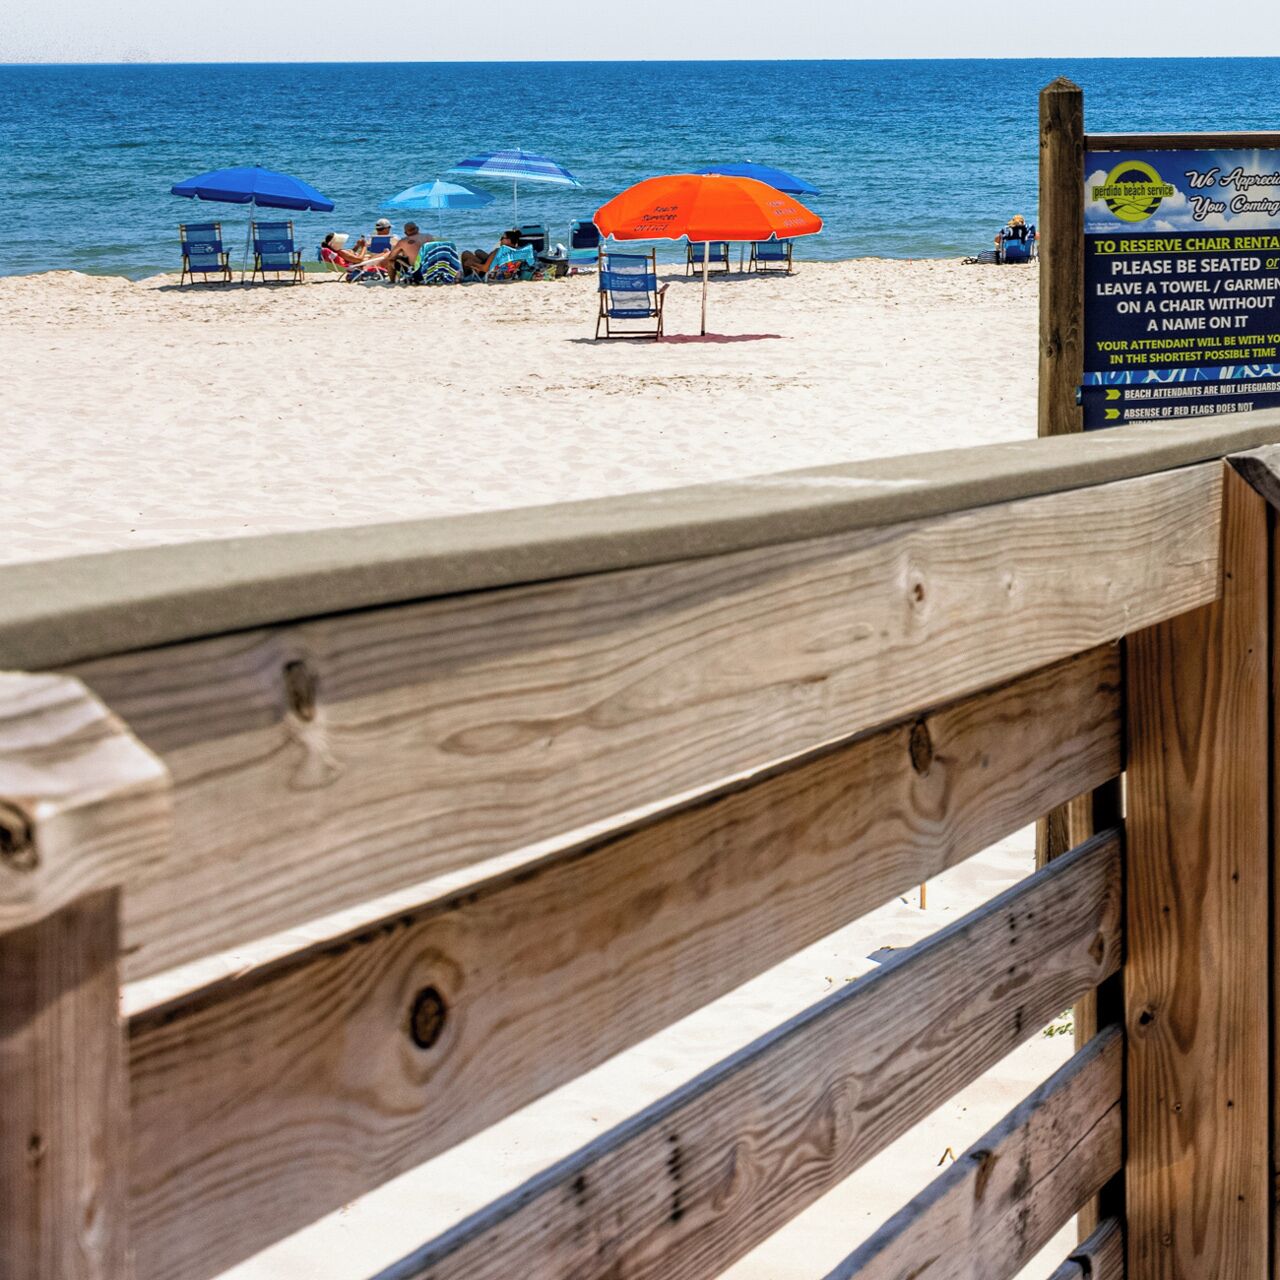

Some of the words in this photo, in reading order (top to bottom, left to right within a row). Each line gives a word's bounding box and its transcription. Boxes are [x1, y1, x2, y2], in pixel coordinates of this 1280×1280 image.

[1185, 168, 1220, 188] We
[1094, 185, 1122, 198] perdido
[1124, 185, 1145, 196] beach
[1148, 184, 1173, 196] service
[1189, 195, 1225, 221] You
[1094, 240, 1116, 252] TO
[1120, 238, 1182, 252] RESERVE
[1185, 237, 1231, 250] CHAIR
[1112, 260, 1172, 275] PLEASE
[1177, 260, 1196, 273] BE
[1200, 258, 1260, 272] SEATED
[1266, 258, 1280, 269] or
[1096, 282, 1142, 296] LEAVE
[1145, 282, 1157, 294] A
[1160, 280, 1210, 294] TOWEL
[1213, 280, 1221, 294] /
[1116, 300, 1140, 313] ON
[1144, 300, 1156, 312] A
[1160, 298, 1205, 312] CHAIR
[1208, 296, 1276, 310] WITHOUT
[1147, 320, 1158, 332] A
[1162, 317, 1206, 330] NAME
[1209, 316, 1232, 328] ON
[1234, 316, 1248, 328] IT
[1096, 341, 1128, 351] YOUR
[1130, 338, 1195, 350] ATTENDANT
[1196, 337, 1222, 347] WILL
[1224, 336, 1236, 346] BE
[1238, 335, 1264, 345] WITH
[1110, 354, 1123, 364] IN
[1126, 353, 1148, 364] THE
[1150, 351, 1202, 362] SHORTEST
[1204, 348, 1250, 360] POSSIBLE
[1252, 348, 1276, 357] TIME
[1124, 388, 1151, 399] BEACH
[1153, 386, 1202, 398] ATTENDANTS
[1204, 385, 1218, 394] ARE
[1220, 384, 1236, 394] NOT
[1124, 407, 1160, 418] ABSENSE
[1162, 406, 1173, 416] OF
[1174, 406, 1189, 416] RED
[1190, 404, 1214, 414] FLAGS
[1216, 402, 1236, 412] DOES
[1238, 402, 1254, 412] NOT
